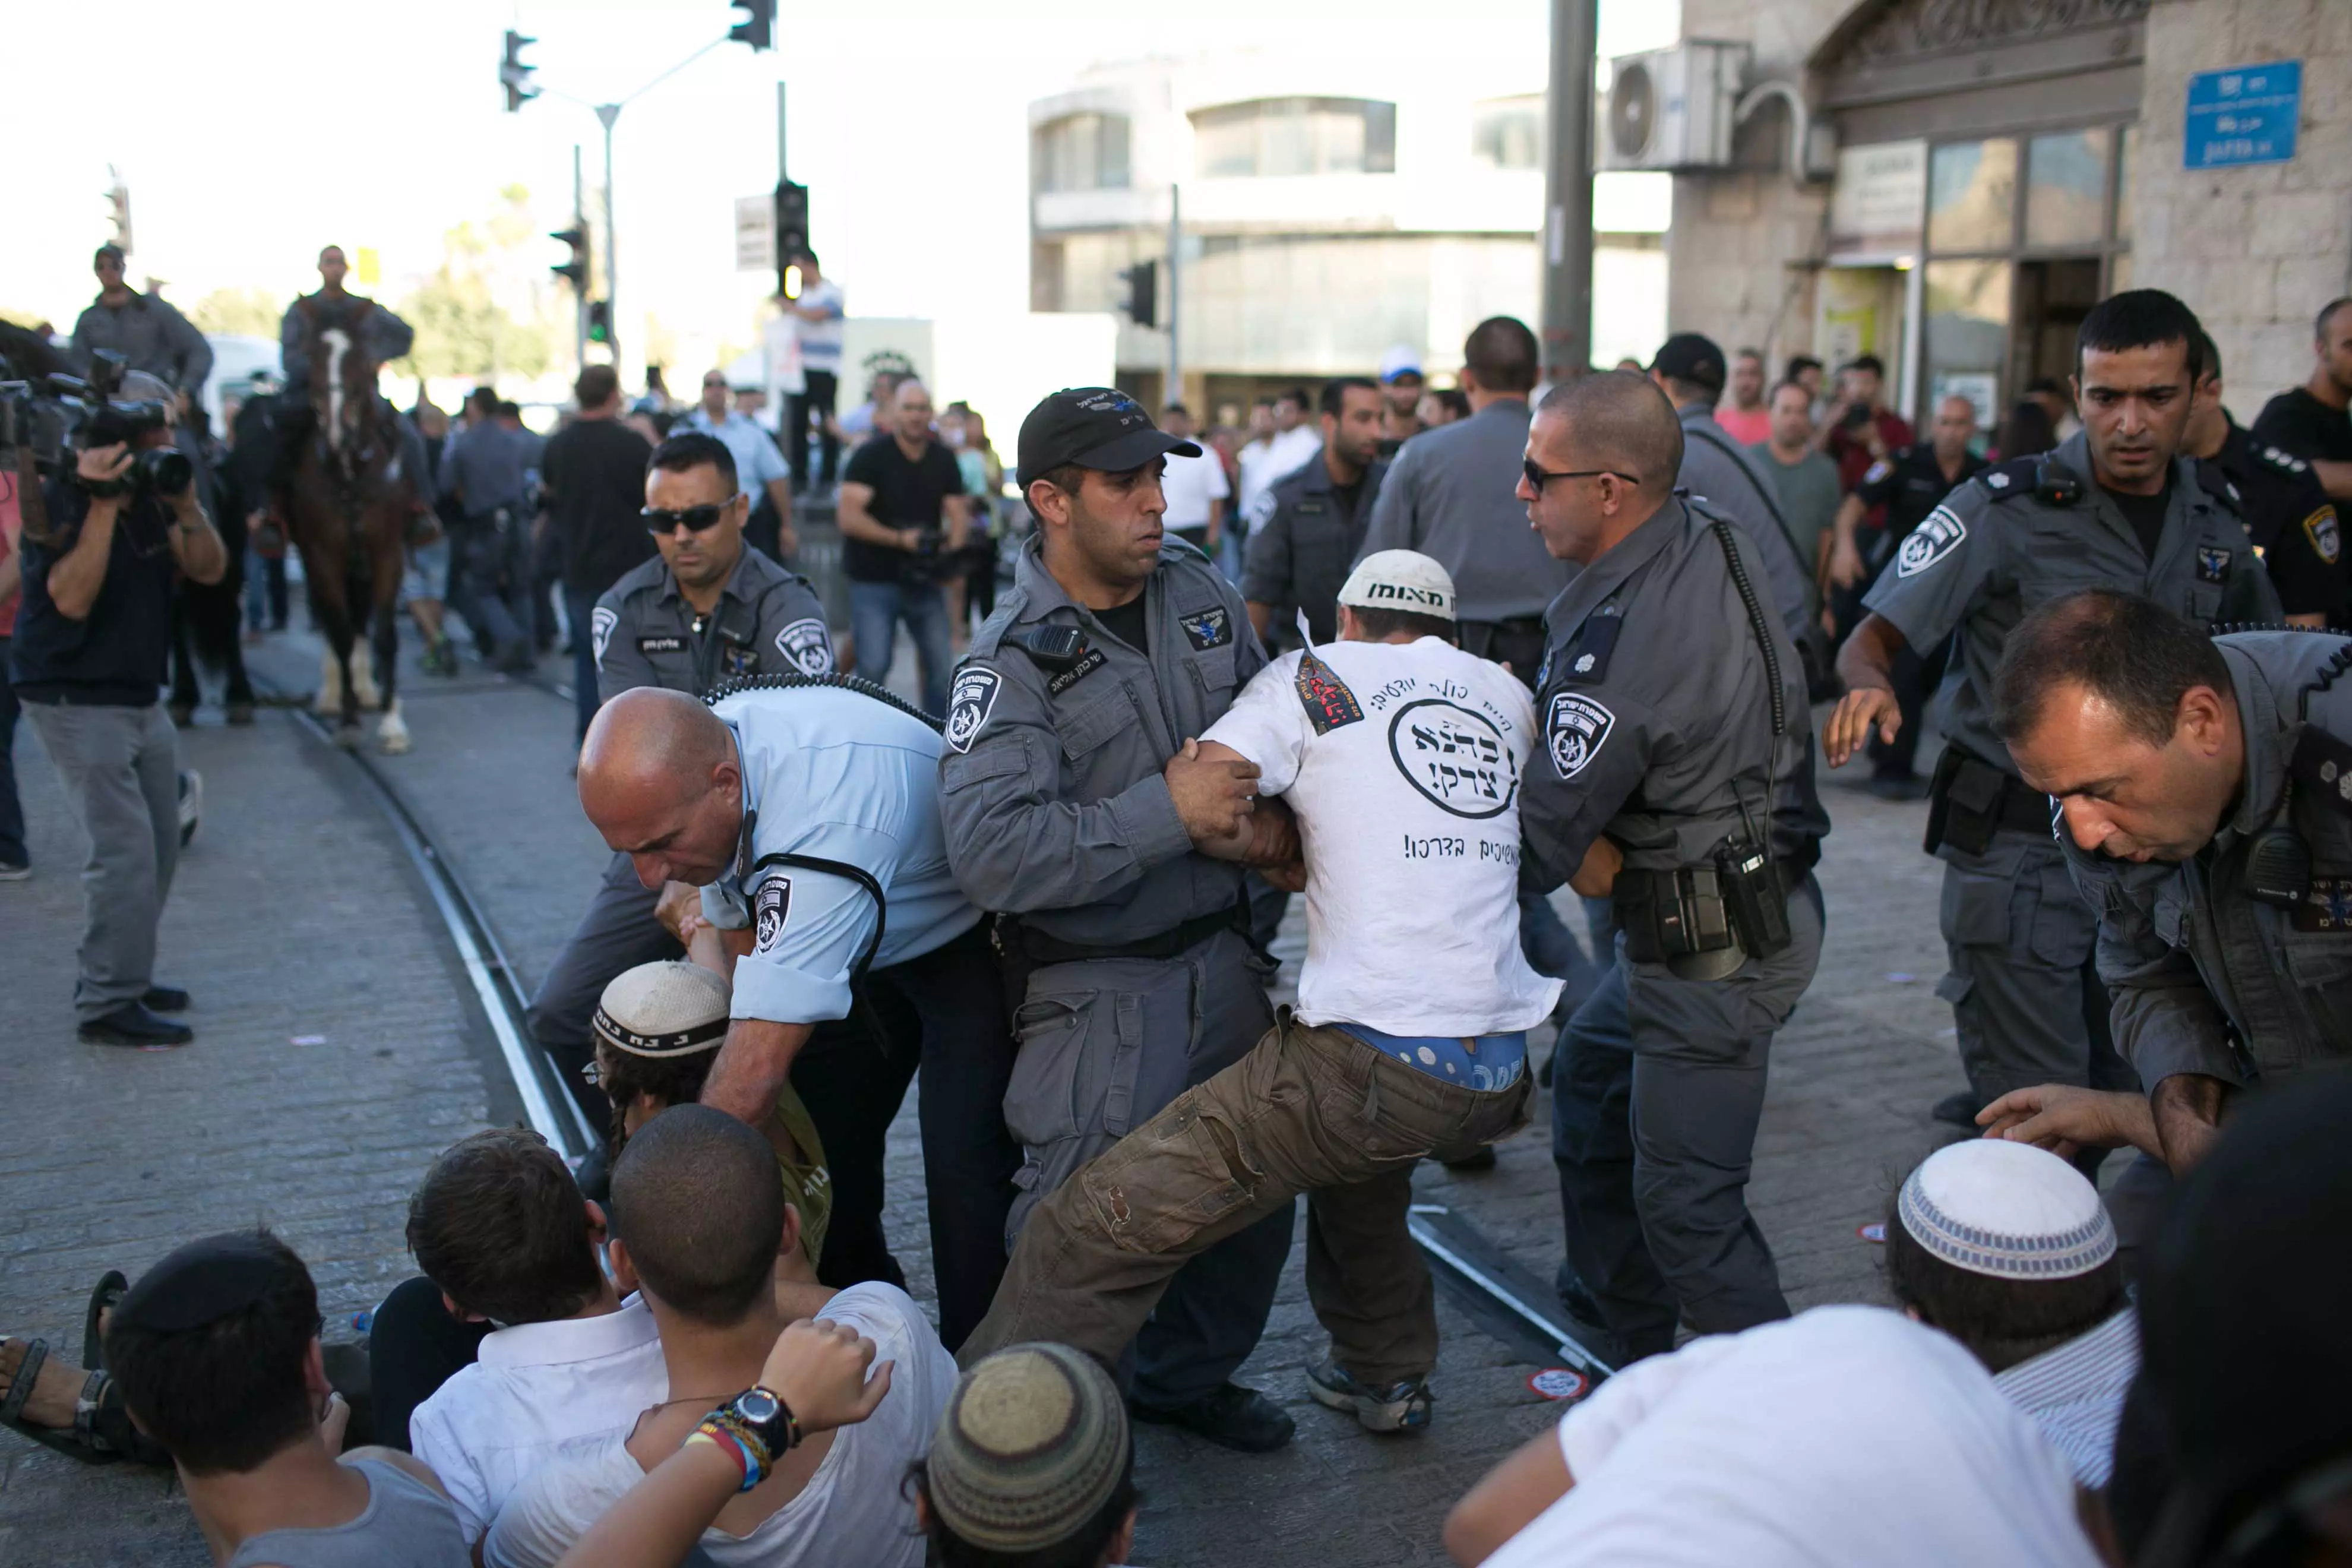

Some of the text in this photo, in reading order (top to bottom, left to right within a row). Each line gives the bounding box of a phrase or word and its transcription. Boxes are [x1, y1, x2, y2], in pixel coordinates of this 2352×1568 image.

[1367, 583, 1443, 606] מאומן
[1428, 763, 1499, 799] צדק!
[1404, 834, 1465, 858] בדרכו!
[629, 1035, 659, 1047] נח
